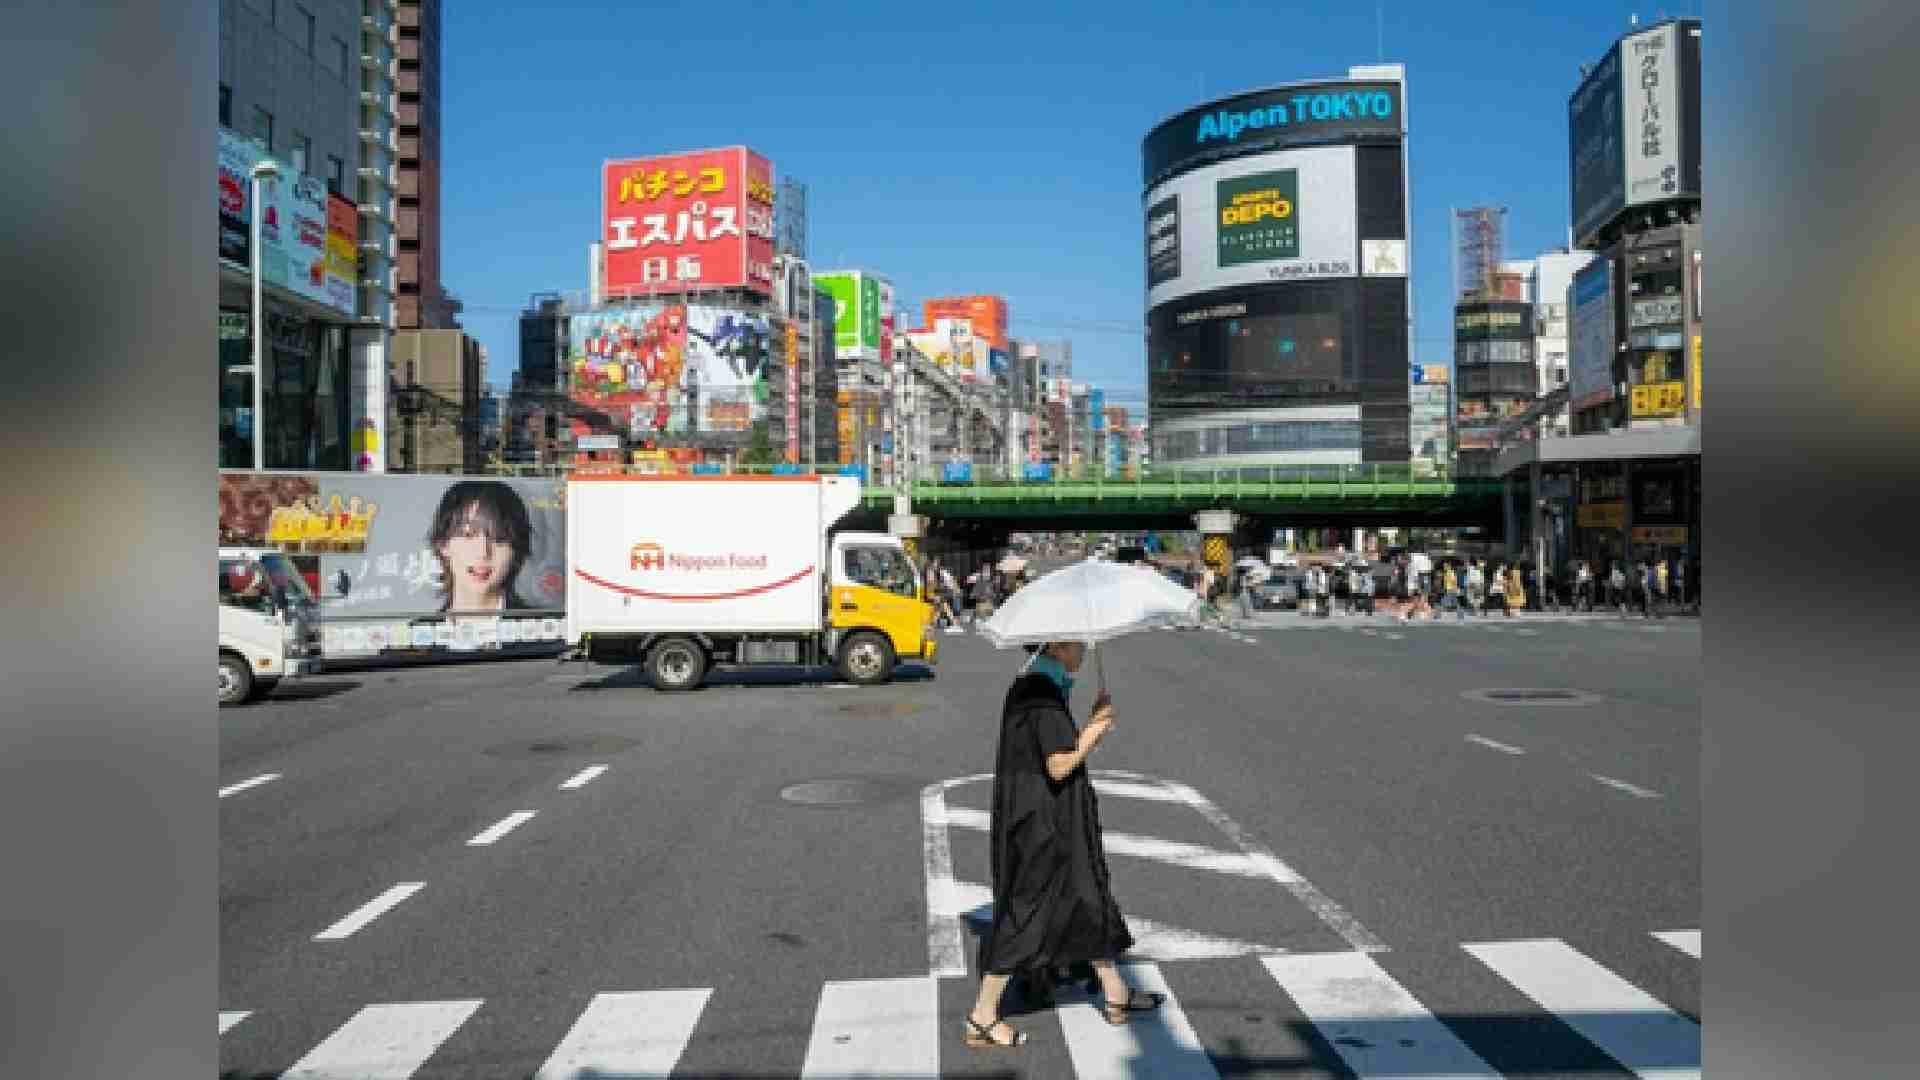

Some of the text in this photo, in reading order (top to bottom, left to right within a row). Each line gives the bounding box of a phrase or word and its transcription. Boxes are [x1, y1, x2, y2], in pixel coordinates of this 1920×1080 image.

[1198, 91, 1391, 142] Alpen TOKYO
[618, 167, 727, 203] パチンコ
[608, 201, 741, 249] エスパス
[1222, 199, 1293, 224] DEPO
[668, 552, 727, 573] Nippon
[730, 552, 768, 570] Food
